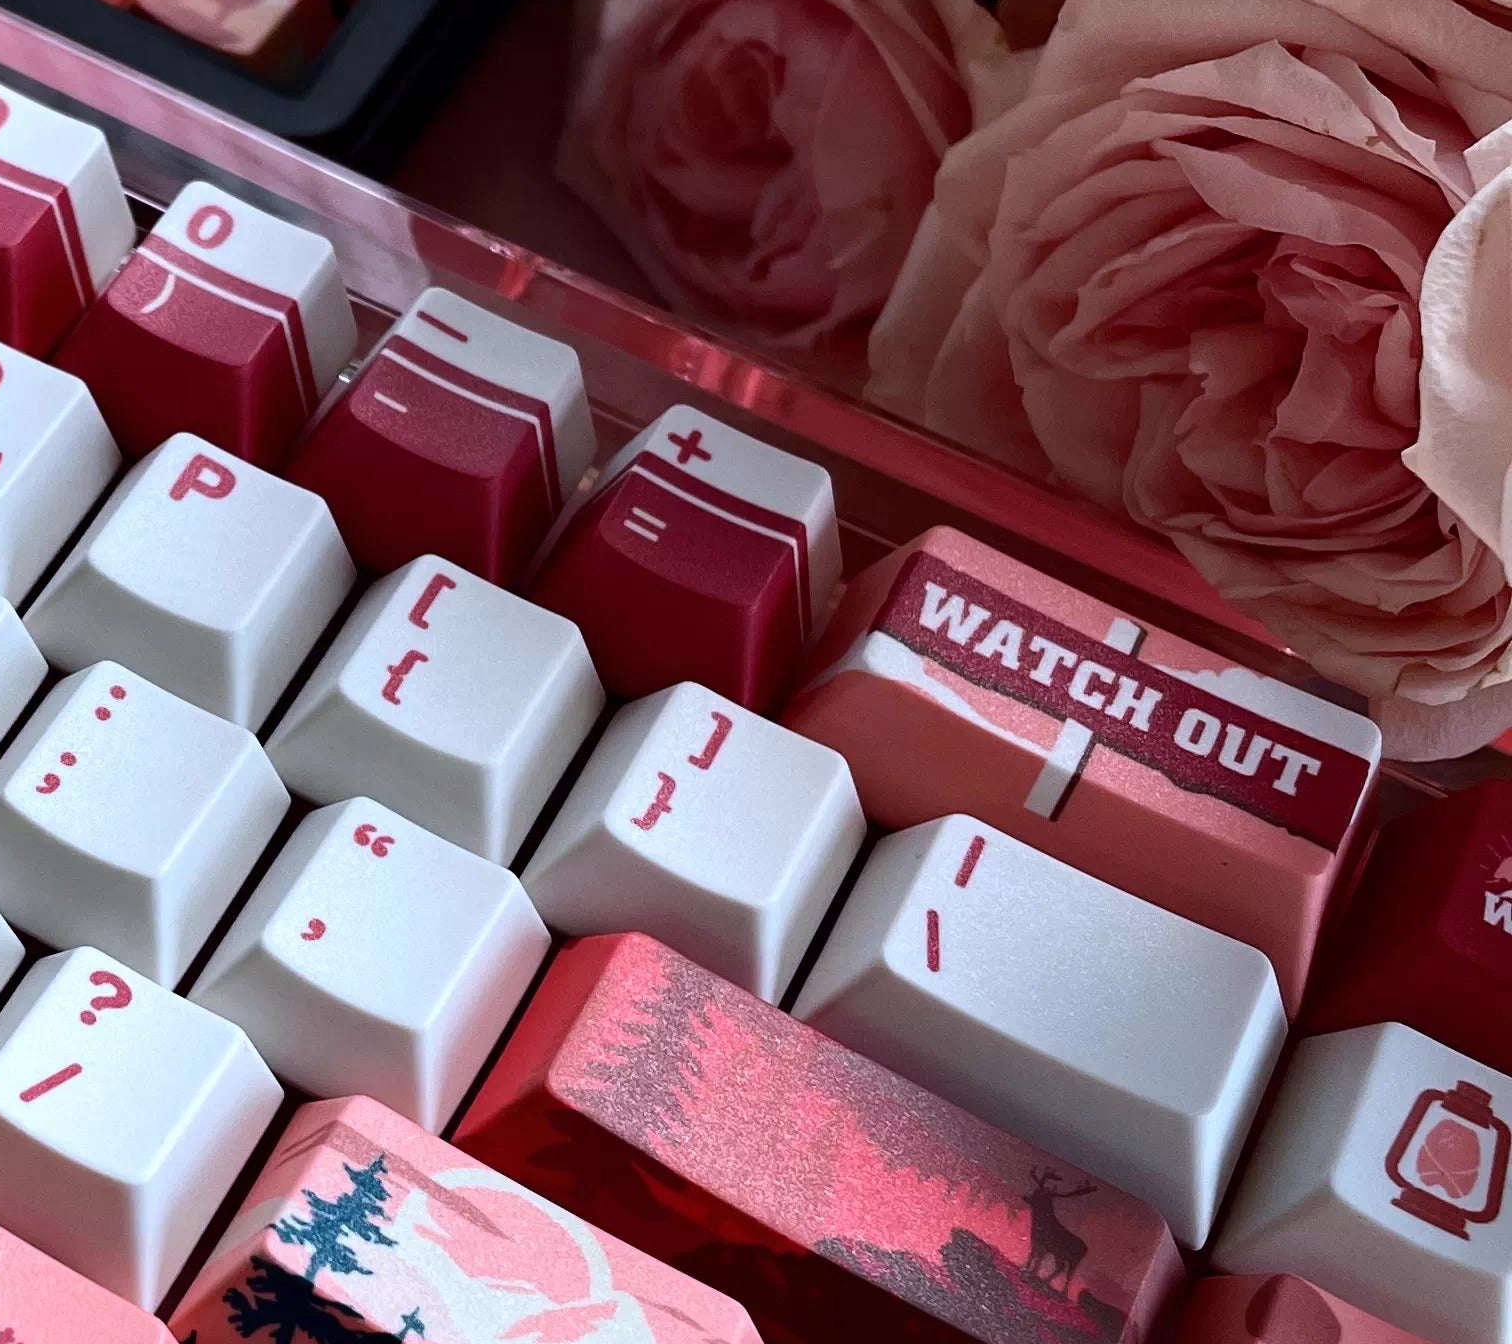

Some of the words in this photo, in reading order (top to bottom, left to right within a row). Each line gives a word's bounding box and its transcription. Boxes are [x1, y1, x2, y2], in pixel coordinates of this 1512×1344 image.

[186, 204, 234, 248] 0
[141, 274, 176, 314] )
[667, 429, 712, 465] +
[169, 454, 237, 501] P
[624, 507, 666, 542] =
[409, 573, 456, 629] [
[95, 686, 125, 720] :
[918, 581, 1163, 732] WATCH
[1174, 708, 1323, 796] OUT
[688, 712, 732, 770] ]
[37, 752, 76, 794] ;
[81, 971, 132, 1024] ?
[20, 1064, 82, 1102] /
